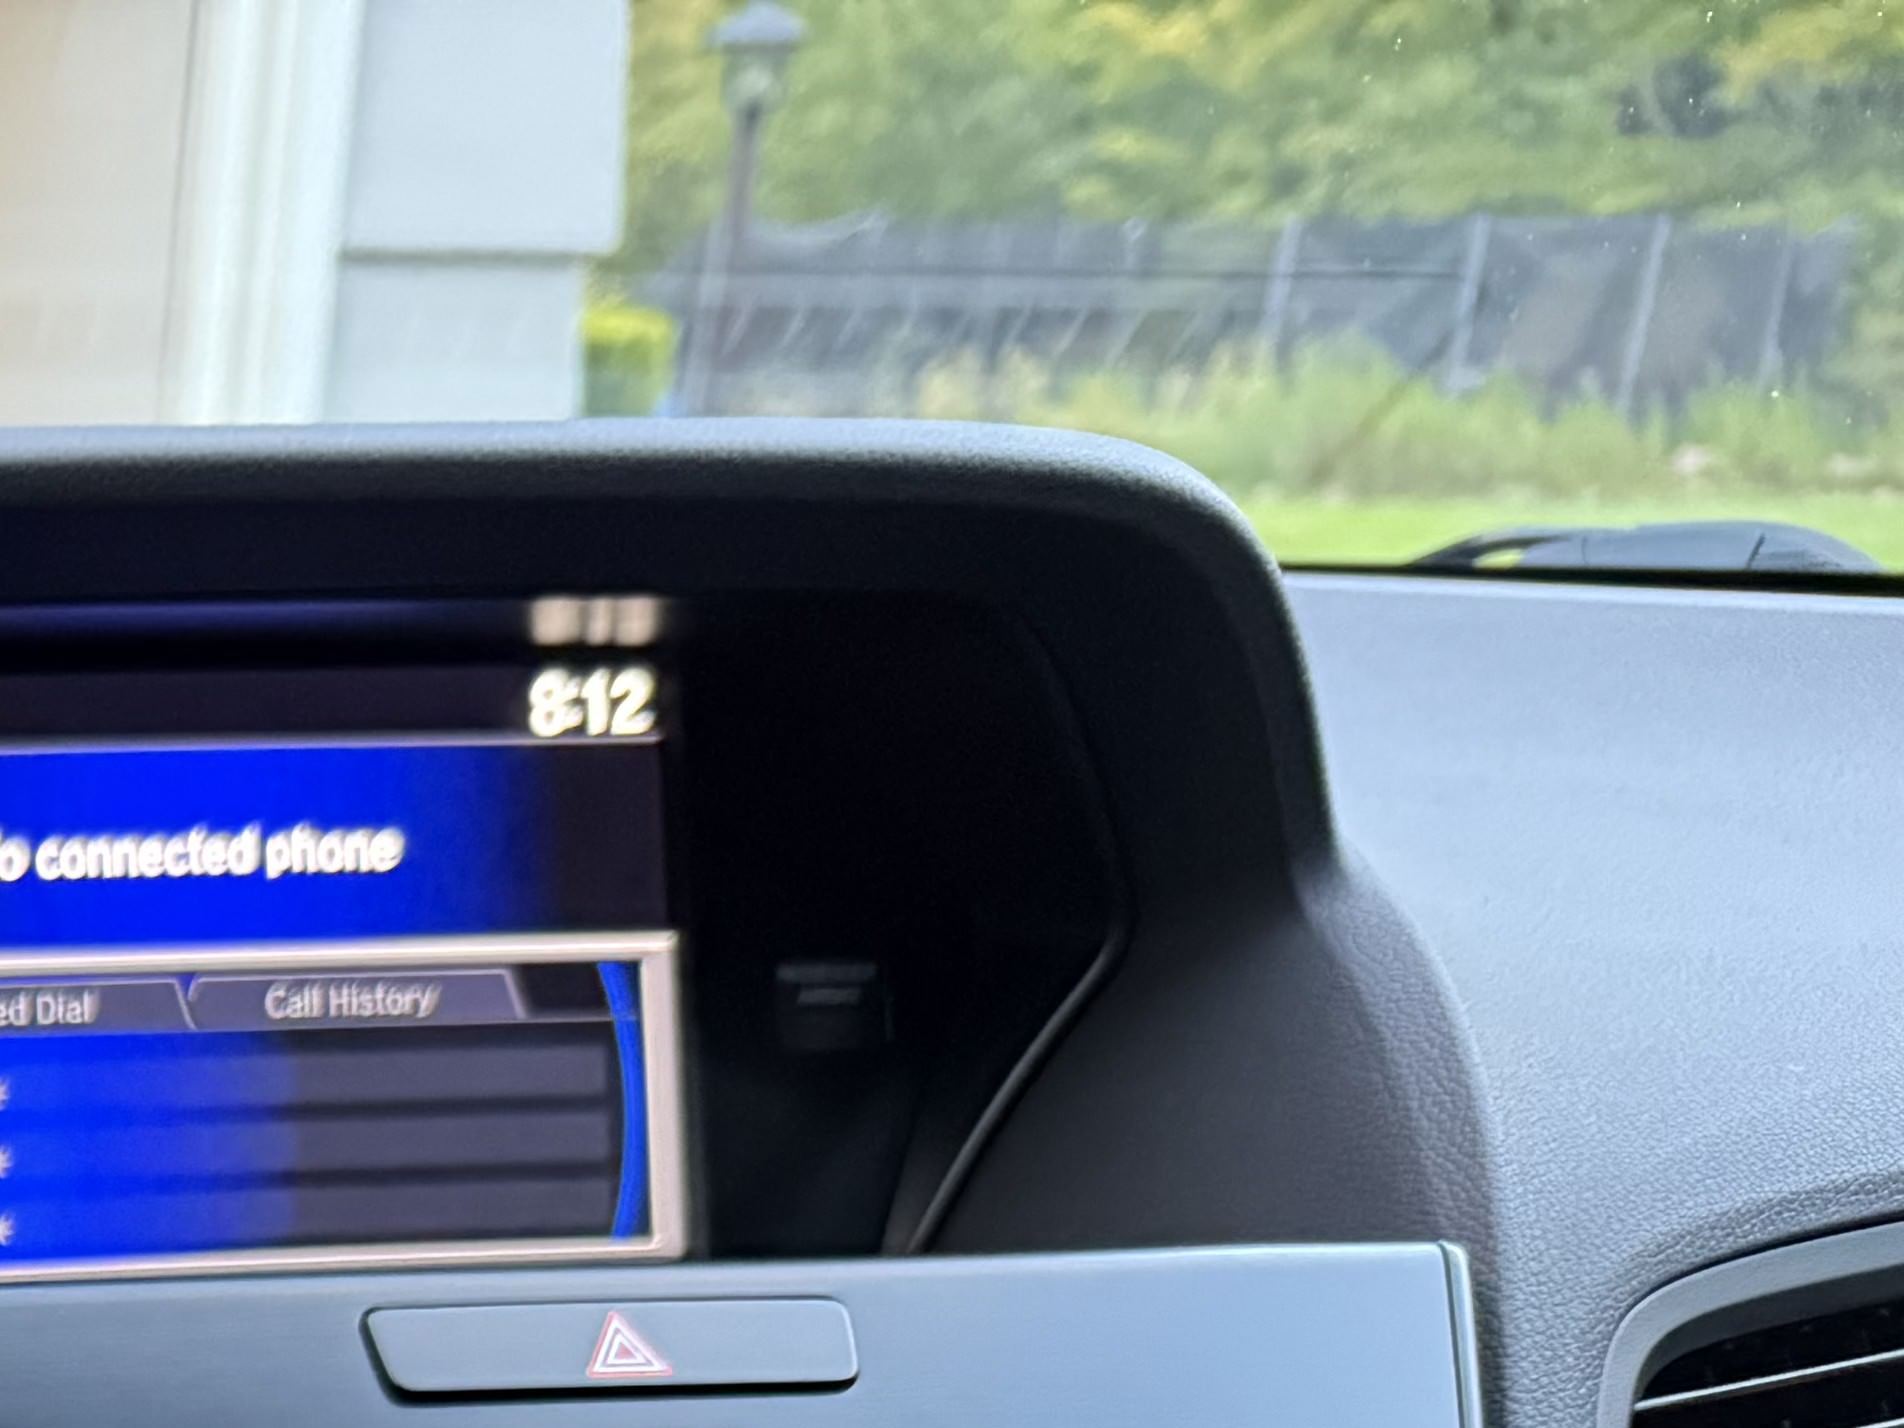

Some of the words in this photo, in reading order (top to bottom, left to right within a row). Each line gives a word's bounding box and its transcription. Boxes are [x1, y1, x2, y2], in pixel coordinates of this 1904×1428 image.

[529, 668, 658, 738] 8:12
[35, 819, 261, 882] connected
[265, 818, 405, 881] phone
[35, 985, 101, 1025] Dial
[264, 980, 323, 1020] Call
[326, 977, 442, 1020] History
